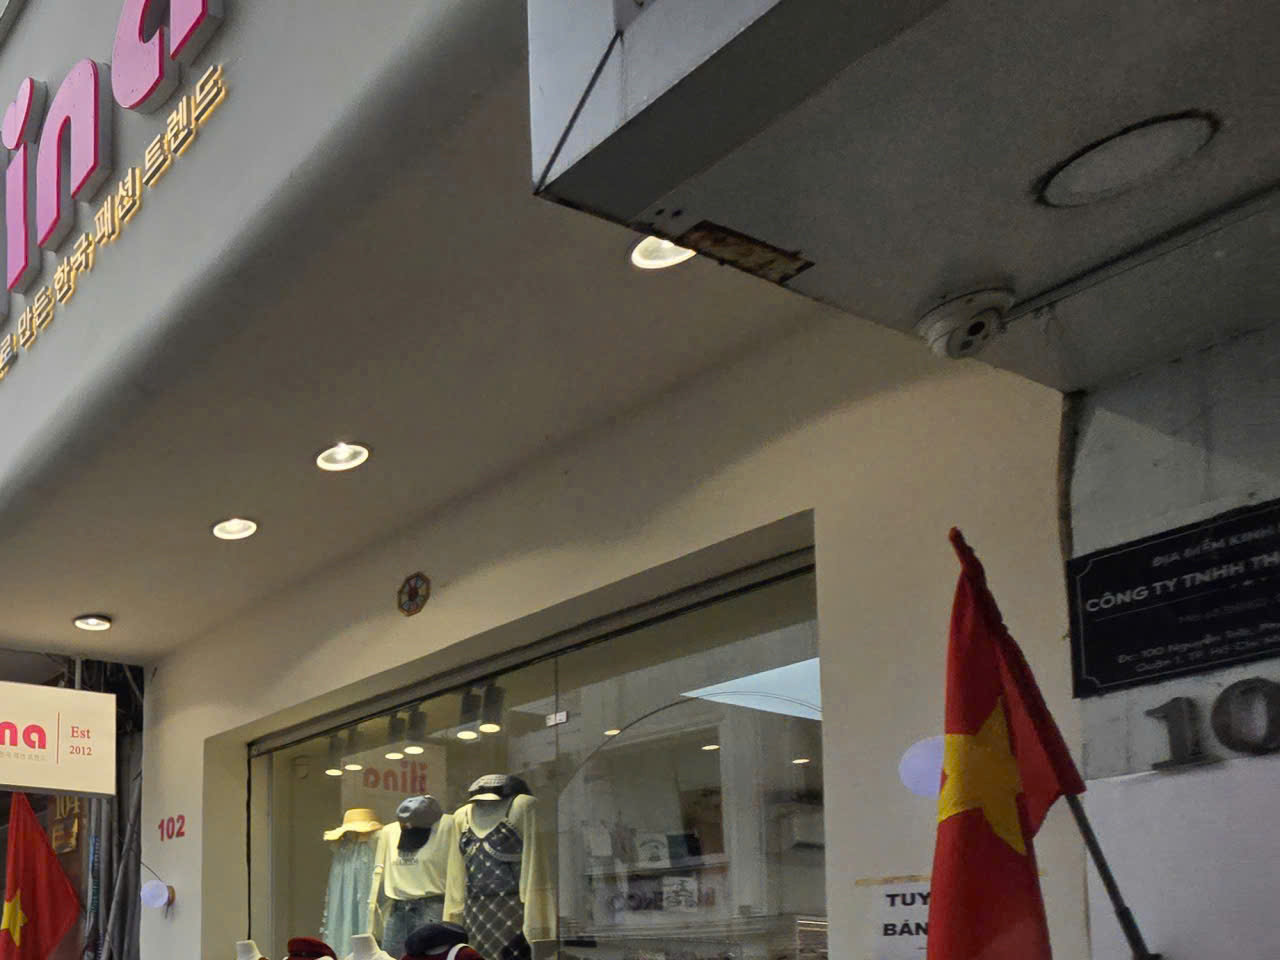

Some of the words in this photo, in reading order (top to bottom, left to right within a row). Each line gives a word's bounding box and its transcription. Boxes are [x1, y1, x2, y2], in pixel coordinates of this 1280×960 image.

[17, 286, 53, 349] 만든
[53, 232, 94, 304] 한국
[94, 166, 141, 247] 패션
[142, 64, 227, 188] 트렌드
[1086, 586, 1149, 612] CÔNG
[1152, 577, 1178, 595] TY
[1182, 560, 1246, 588] TNHH
[70, 725, 91, 739] Est
[69, 744, 93, 756] 2012
[158, 814, 186, 842] 102
